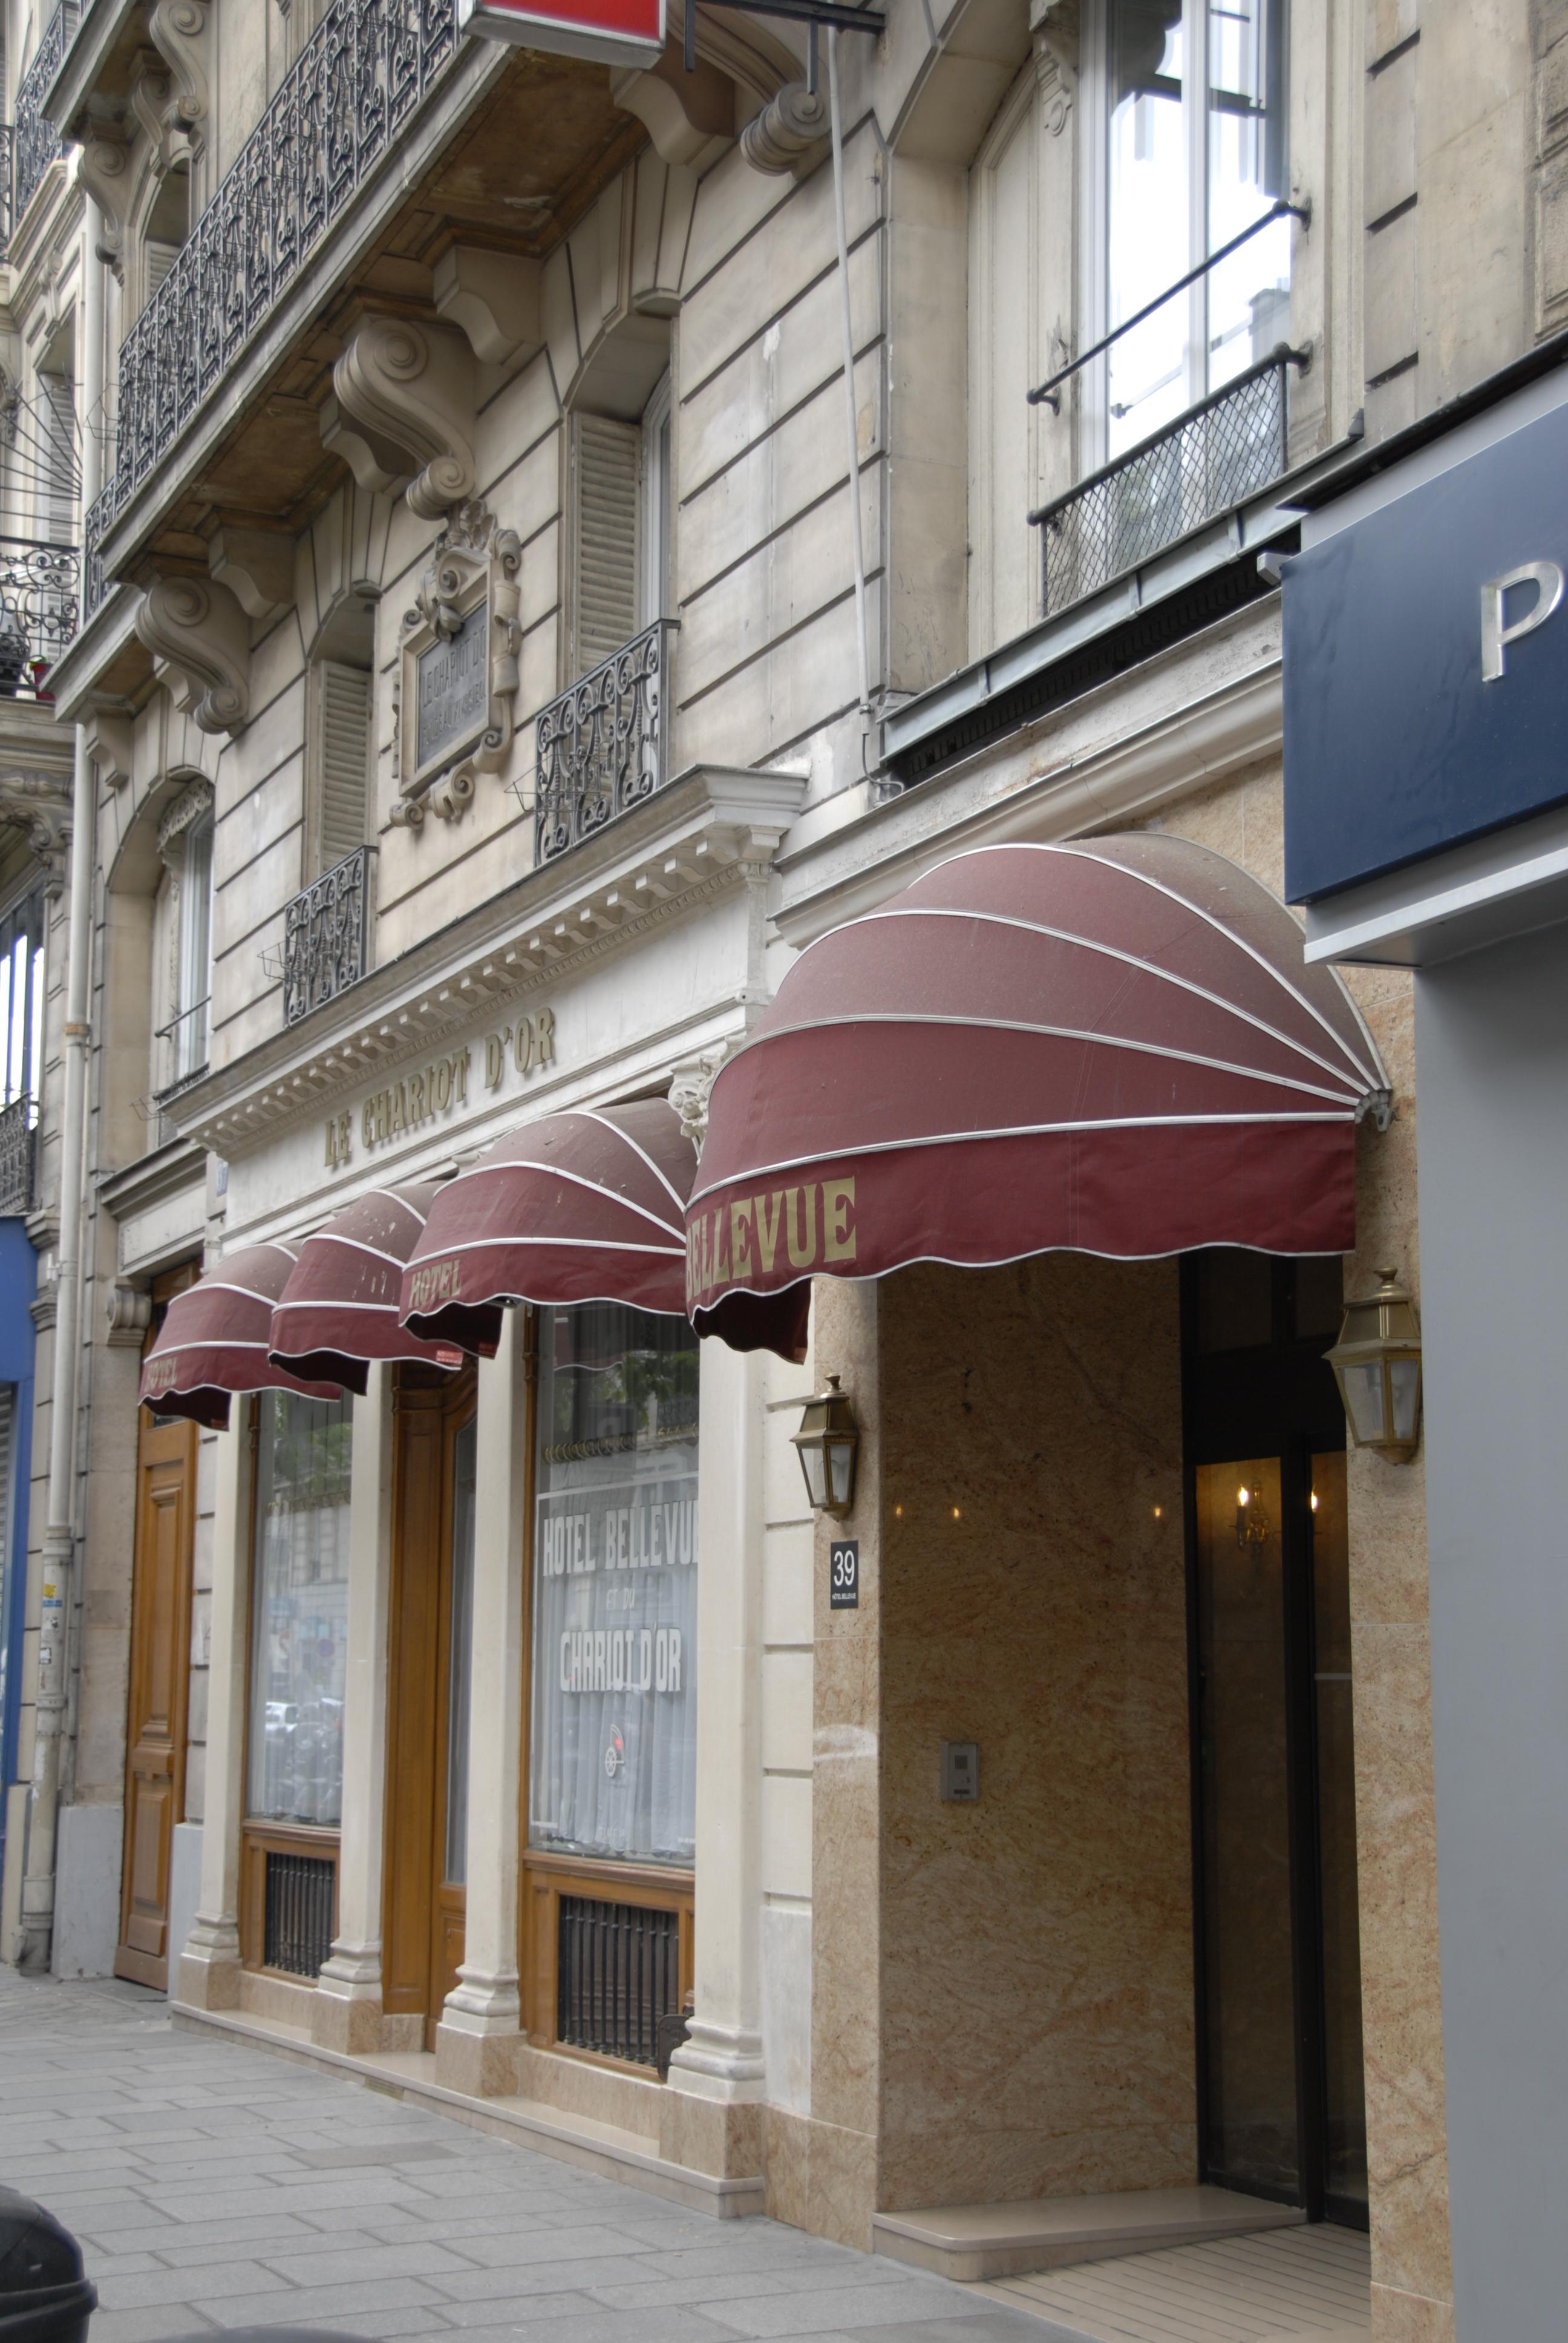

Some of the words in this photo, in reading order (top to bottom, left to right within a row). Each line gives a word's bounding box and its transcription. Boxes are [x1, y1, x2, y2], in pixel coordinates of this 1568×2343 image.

[1481, 562, 1564, 682] P
[434, 637, 470, 699] CHARIOT
[325, 1110, 351, 1167] LE
[362, 1046, 469, 1149] CHARIOT
[485, 1007, 554, 1089] D'OR
[687, 1175, 856, 1303] BELLEVUE
[408, 1259, 461, 1309] HOTEL
[145, 1356, 178, 1393] HOTEL
[543, 1513, 596, 1576] HOTEL
[834, 1550, 855, 1586] 39
[606, 1588, 618, 1610] ET
[623, 1587, 635, 1610] DU
[560, 1629, 635, 1692] CHARIOT
[639, 1621, 681, 1692] D'OR
